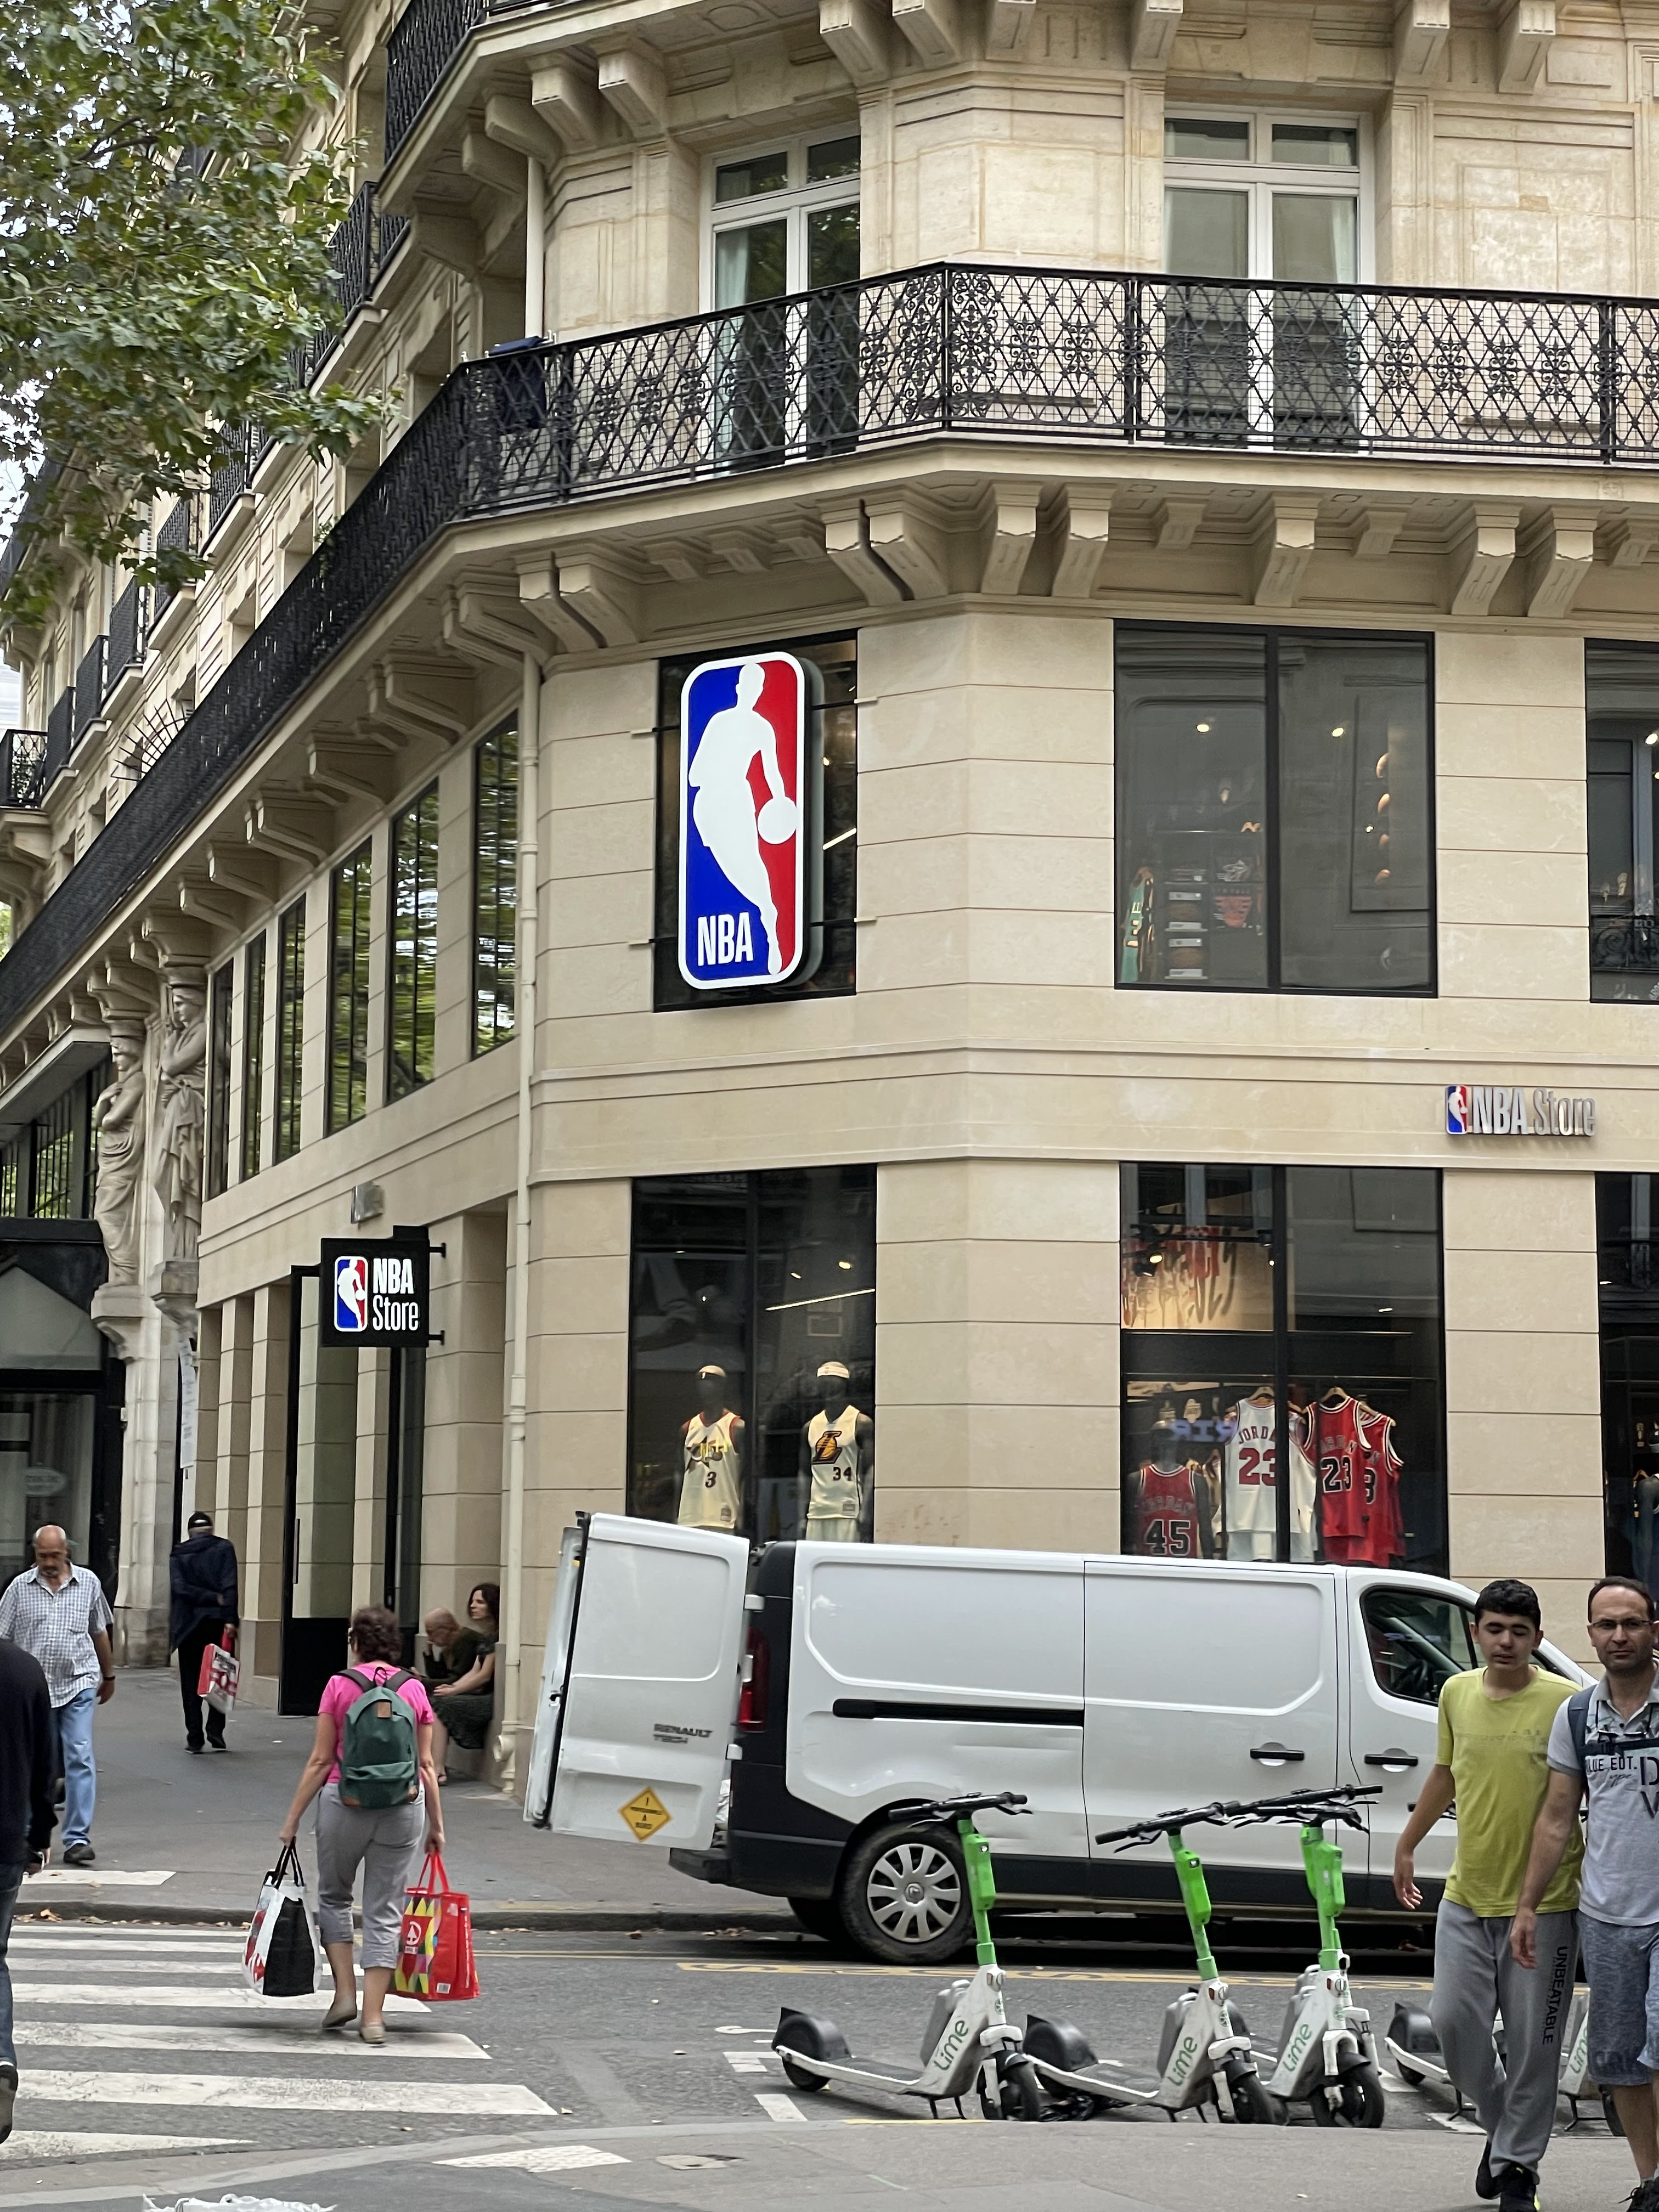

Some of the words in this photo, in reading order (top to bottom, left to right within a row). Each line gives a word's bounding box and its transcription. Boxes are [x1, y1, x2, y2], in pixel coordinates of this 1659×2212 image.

[698, 912, 754, 966] NBA
[1472, 1087, 1528, 1134] NBA
[1533, 1087, 1596, 1136] Store
[373, 1258, 414, 1294] NBA
[373, 1295, 419, 1331] Store
[705, 1471, 716, 1488] 3
[833, 1466, 852, 1481] 34
[1320, 1455, 1353, 1493] 23
[1144, 1519, 1191, 1556] 45
[1542, 1946, 1568, 2045] UNBEATABLE
[934, 2020, 969, 2071] Lime
[1167, 2036, 1198, 2086] Lime
[1283, 2024, 1312, 2072] Lime
